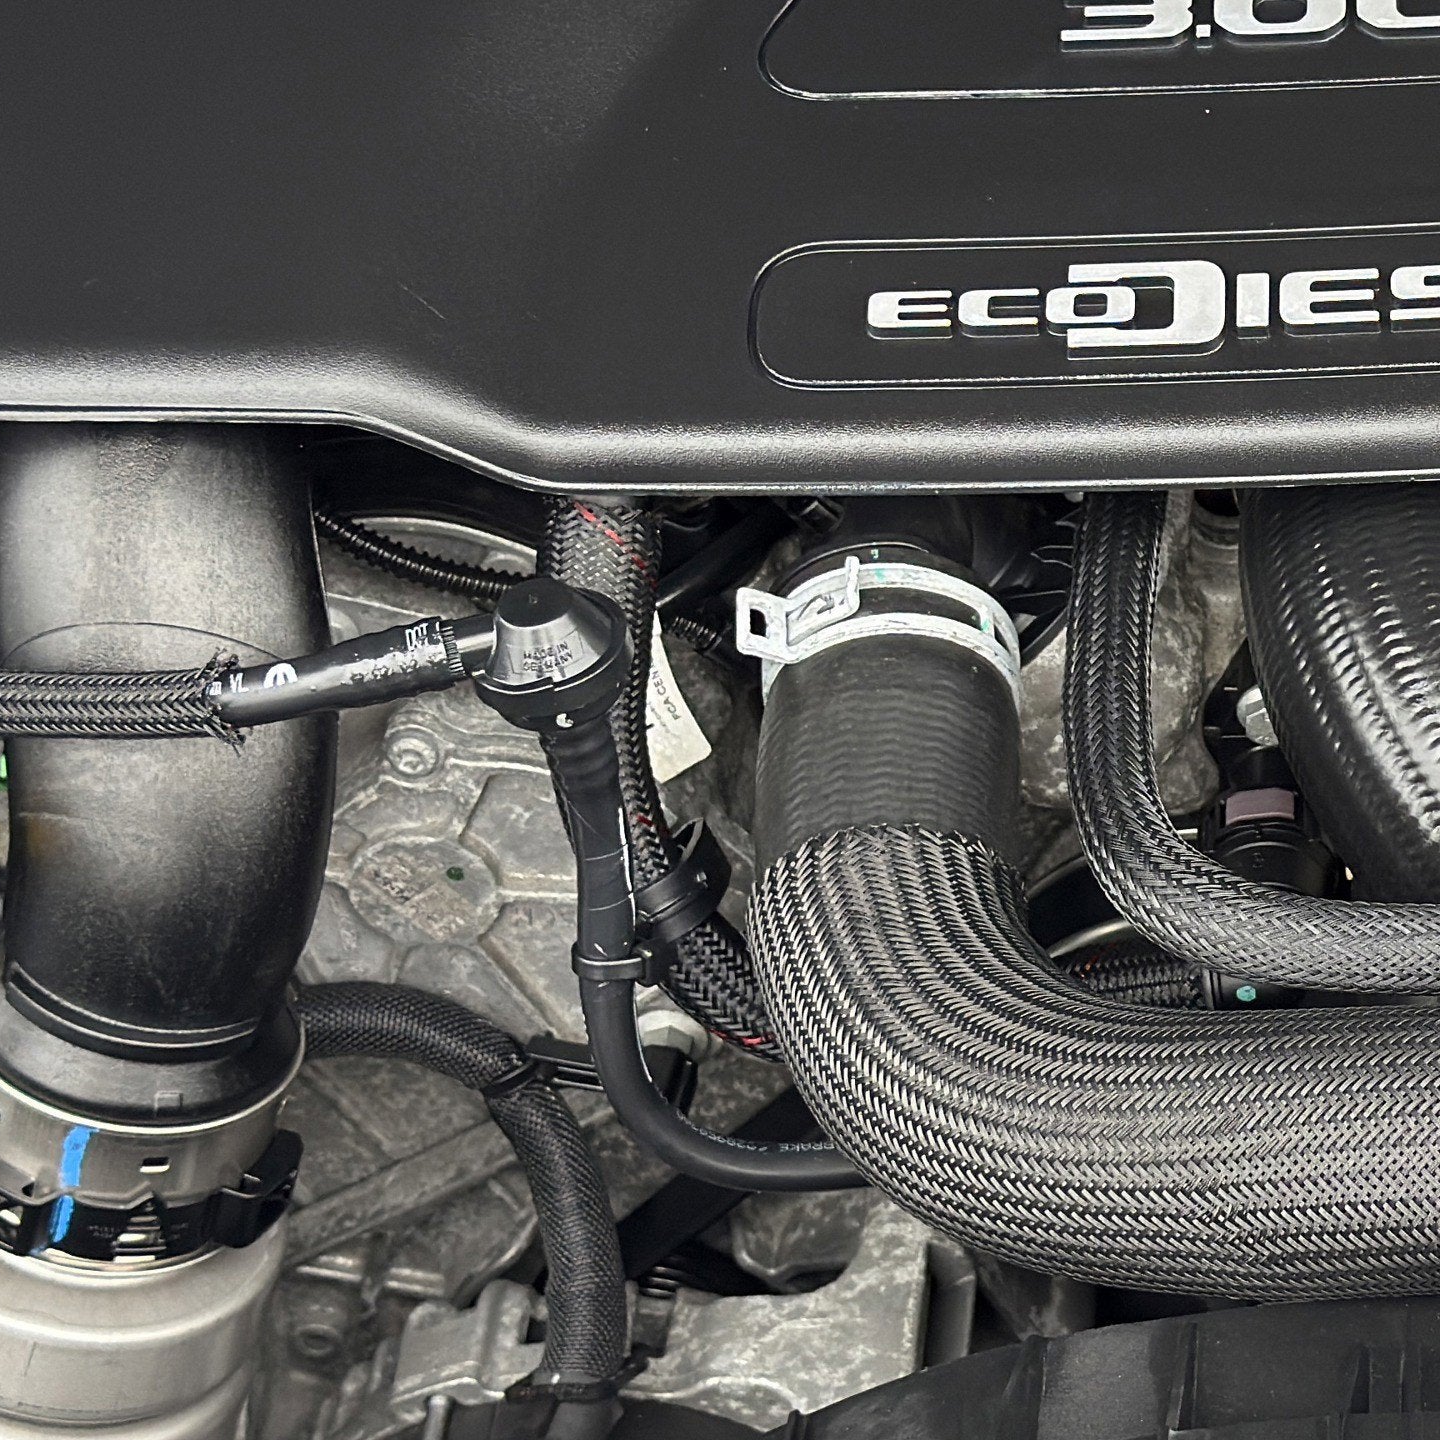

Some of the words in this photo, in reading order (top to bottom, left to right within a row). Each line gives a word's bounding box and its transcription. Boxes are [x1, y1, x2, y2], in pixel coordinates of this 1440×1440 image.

[523, 646, 555, 661] MADE
[556, 640, 569, 654] IN
[523, 649, 574, 673] GERMANY
